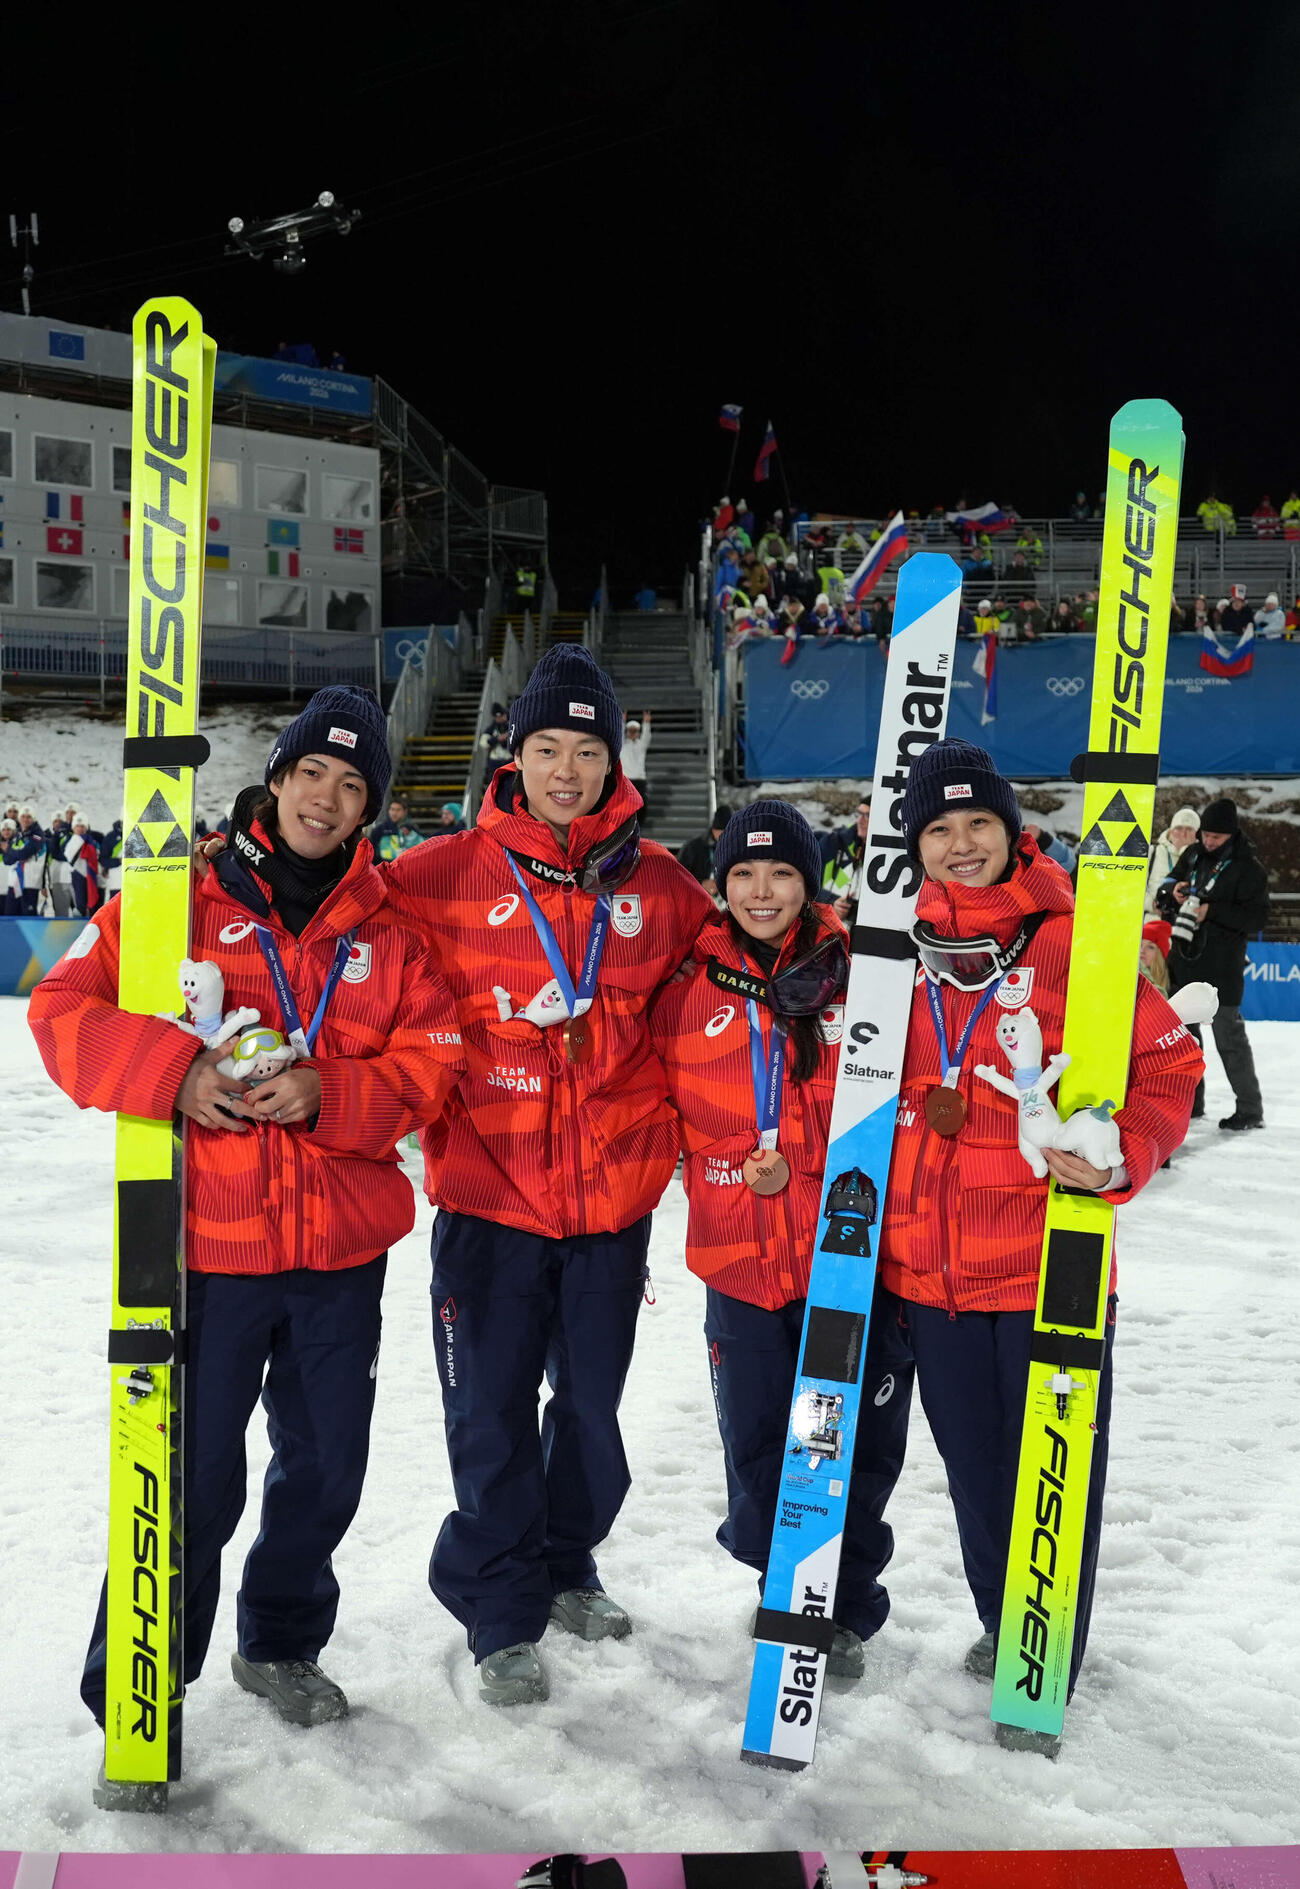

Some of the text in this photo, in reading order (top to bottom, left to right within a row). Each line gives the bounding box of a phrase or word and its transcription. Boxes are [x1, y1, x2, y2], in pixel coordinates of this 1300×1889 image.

[276, 372, 318, 387] MILANO
[571, 708, 593, 717] JAPAN
[331, 734, 355, 745] JAPAN
[947, 789, 970, 798] JAPAN
[234, 830, 266, 867] uvex
[750, 836, 771, 844] JAPAN
[125, 864, 188, 873] FISCHER
[530, 859, 578, 883] uvex
[1082, 862, 1145, 872] FISCHER
[589, 935, 600, 961] CORTINA
[998, 929, 1028, 968] uvex
[273, 961, 284, 989] CORTINA
[585, 960, 594, 987] MILANO
[717, 971, 767, 998] OAKLE
[280, 989, 292, 1017] MILANO
[426, 1032, 462, 1045] TEAM
[1155, 1023, 1192, 1050] TEAM
[487, 1071, 542, 1093] JAPAN
[494, 1066, 526, 1077] TEAM
[771, 1064, 779, 1091] CORTINA
[843, 1063, 895, 1081] Slatnar
[768, 1090, 776, 1117] MILANO
[707, 1156, 730, 1169] TEAM
[704, 1166, 743, 1186] JAPAN
[446, 1345, 457, 1387] JAPAN
[782, 1498, 829, 1517] Improving
[782, 1508, 804, 1520] Your
[780, 1517, 801, 1529] Best
[1015, 1424, 1069, 1702] FISCHER
[131, 1461, 159, 1743] FISCHER
[780, 1585, 827, 1727] Slatar
